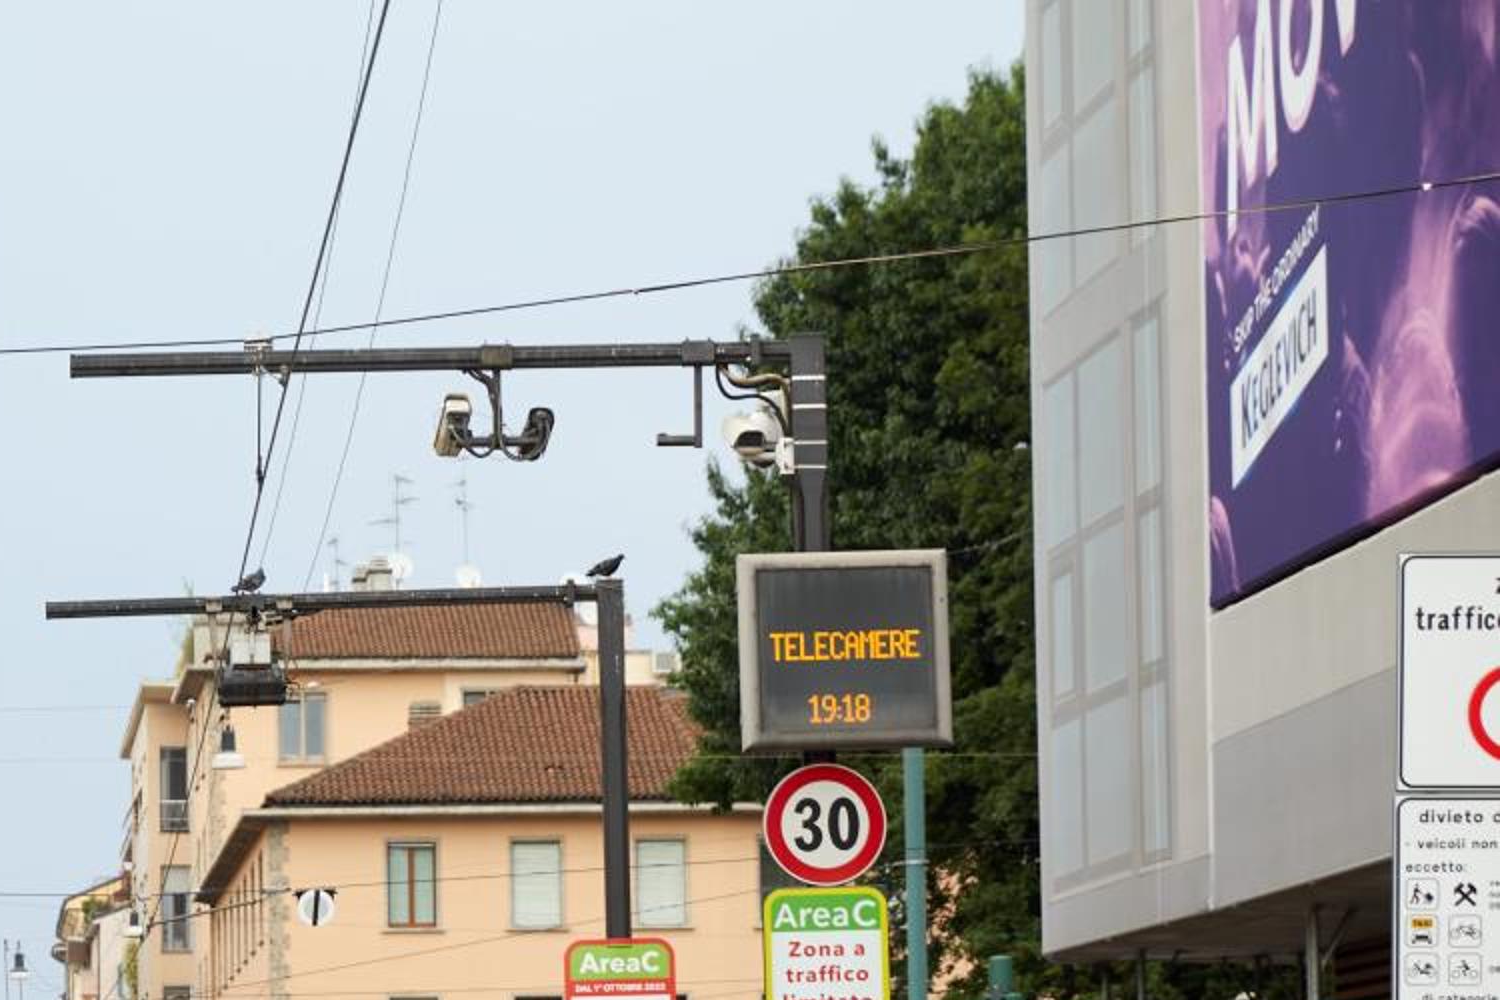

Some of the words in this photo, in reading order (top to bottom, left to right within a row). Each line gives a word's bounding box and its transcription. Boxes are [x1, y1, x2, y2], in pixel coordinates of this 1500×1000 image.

[1234, 305, 1254, 352] SKIP
[1271, 202, 1320, 294] ORDINARY
[1241, 287, 1317, 448] KEGLEVICH
[1415, 604, 1500, 631] traffic
[769, 628, 921, 662] TELECAMERE
[808, 692, 871, 724] 19:18
[794, 796, 860, 852] 30
[1419, 809, 1483, 823] divieto
[1417, 838, 1466, 849] veicoli
[1471, 840, 1498, 849] non
[1405, 862, 1463, 873] eccetto
[580, 950, 660, 973] AreaC
[788, 941, 845, 958] Zona
[853, 943, 866, 957] a
[786, 965, 869, 983] traffico
